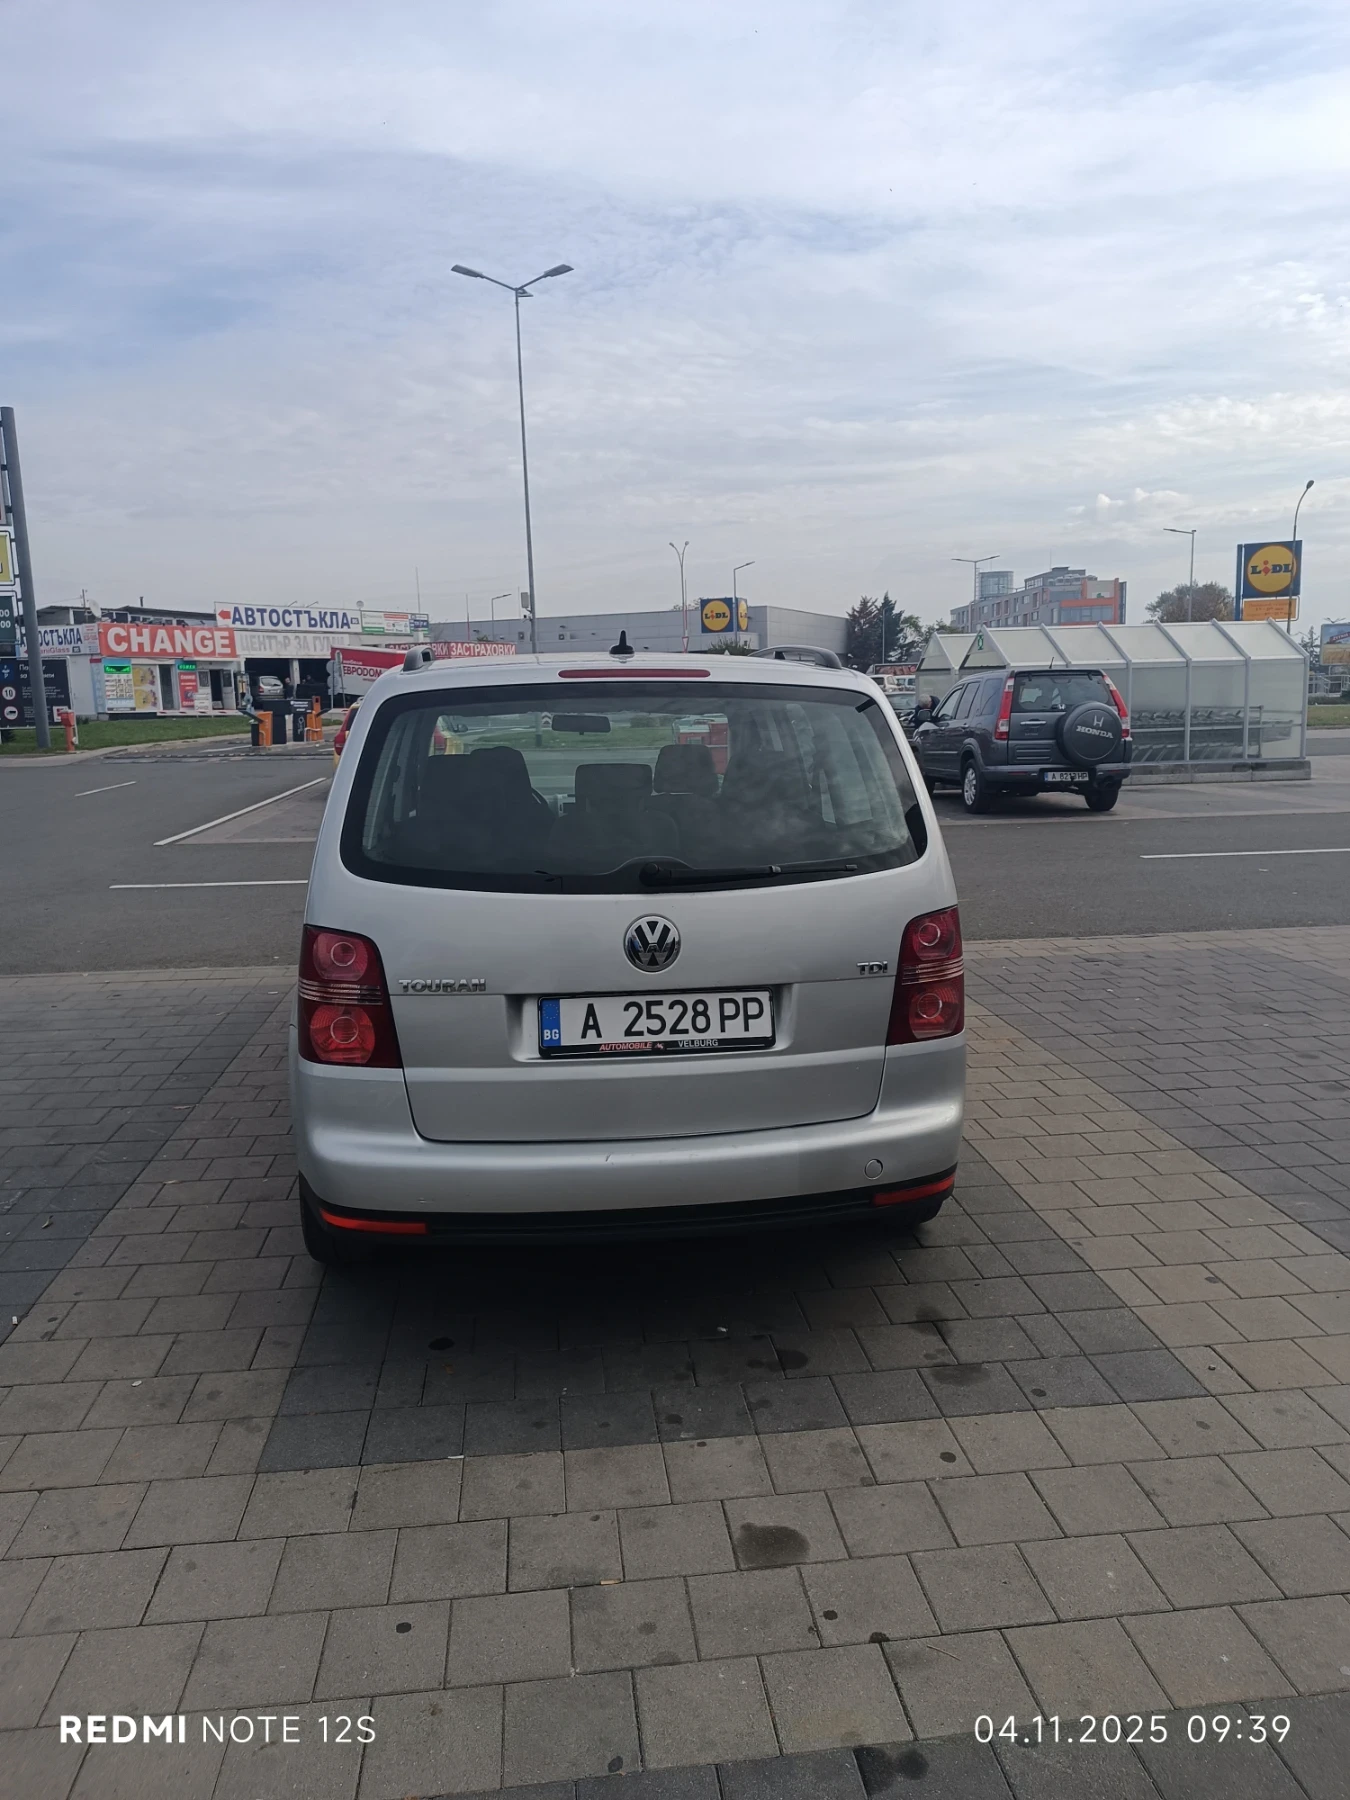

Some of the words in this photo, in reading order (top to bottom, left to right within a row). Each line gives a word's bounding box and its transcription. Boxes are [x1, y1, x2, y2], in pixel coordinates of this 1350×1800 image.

[231, 606, 351, 631] АВТОСТЪКЛА
[106, 626, 231, 654] CHANGE
[239, 634, 292, 655] ЦЕНТЪР
[294, 635, 311, 653] ЗА
[450, 643, 516, 657] ЗАСТРАХОВКИ
[1075, 725, 1114, 739] HONDA
[398, 978, 487, 994] TOURAN
[543, 1029, 560, 1041] BG
[580, 1003, 602, 1040] A
[623, 998, 711, 1038] 2528
[718, 996, 764, 1033] PP
[598, 1041, 654, 1052] AUTOMOBILE
[677, 1038, 719, 1049] VELBURG
